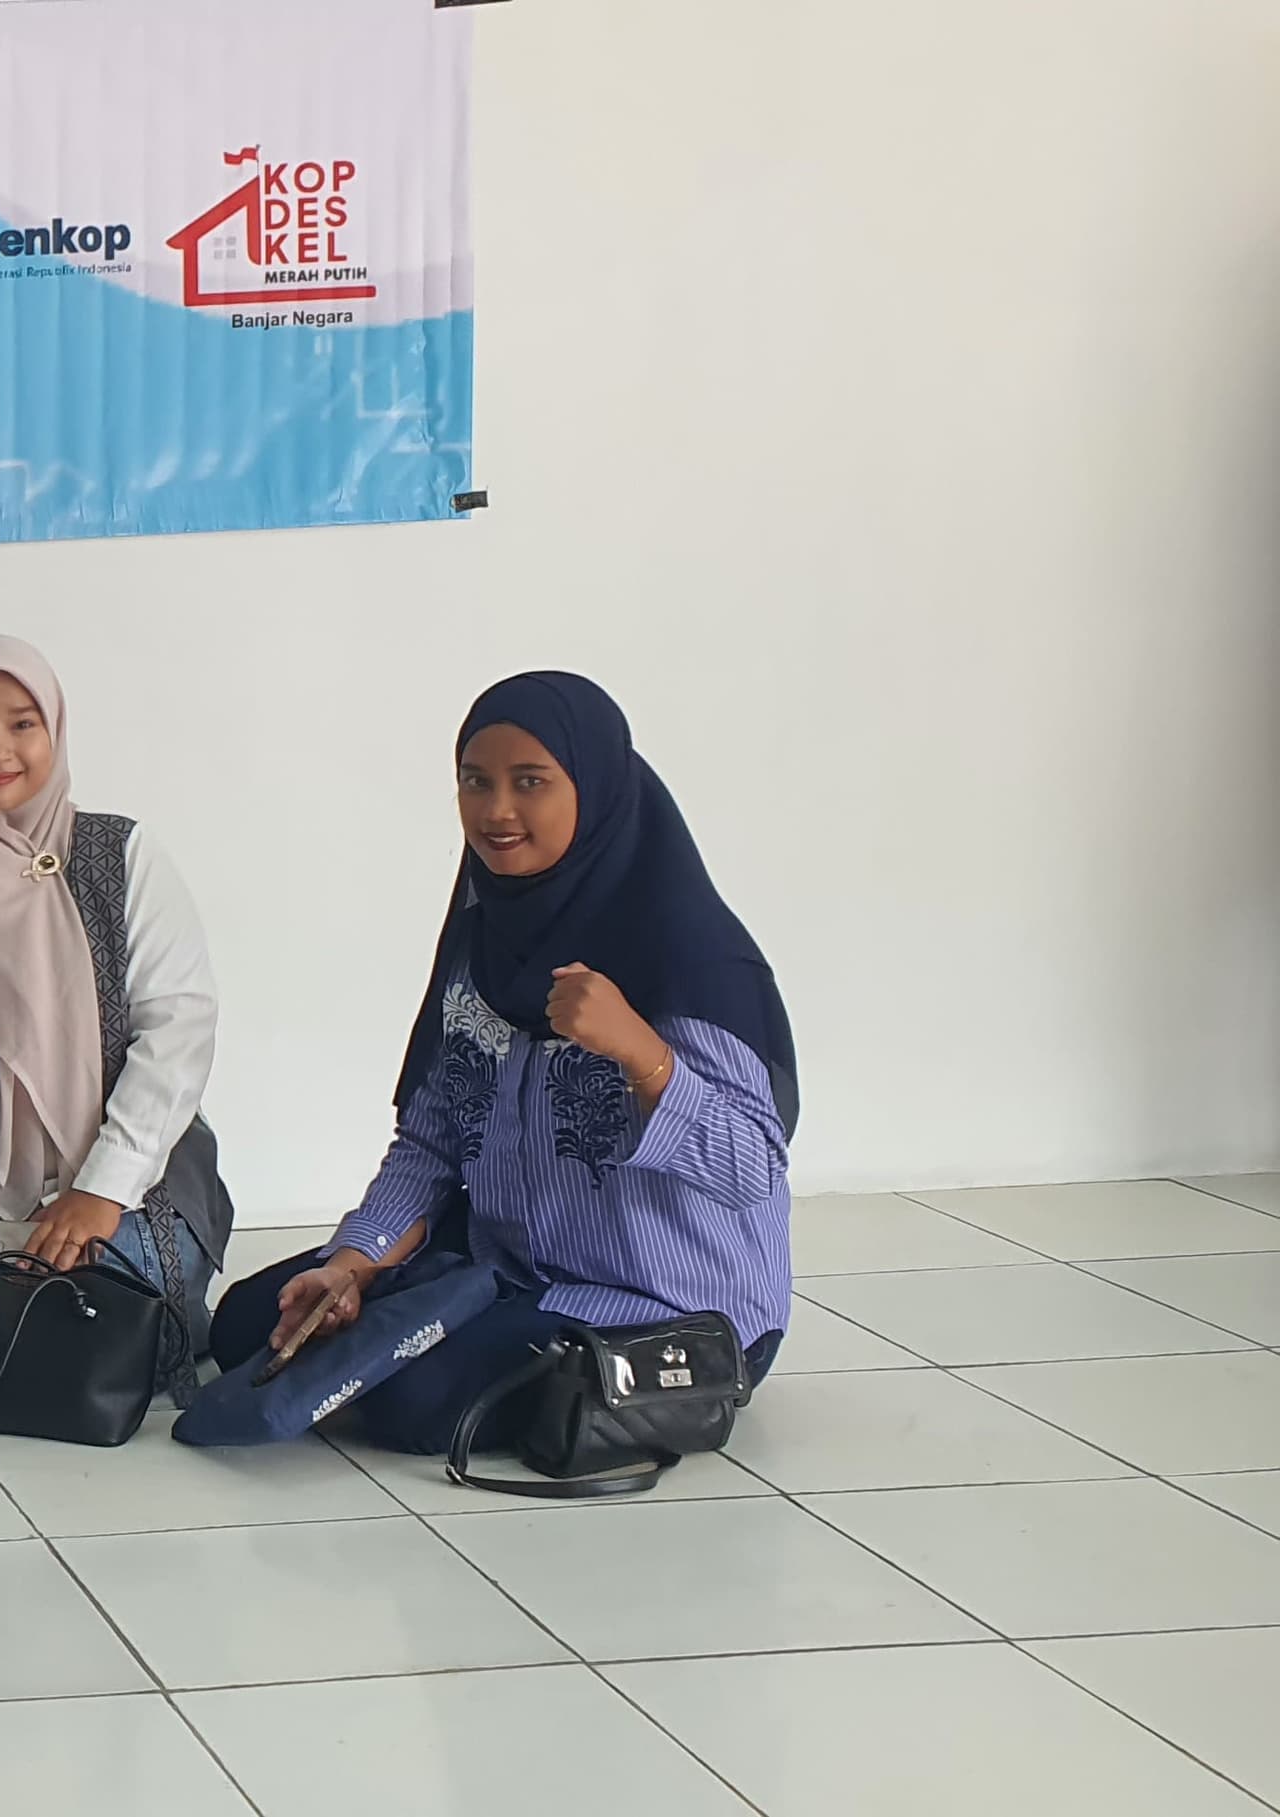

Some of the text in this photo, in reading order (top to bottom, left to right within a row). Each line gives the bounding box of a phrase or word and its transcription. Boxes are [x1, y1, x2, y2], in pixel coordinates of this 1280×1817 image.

[264, 161, 355, 195] KOP
[265, 197, 348, 230] DES
[265, 232, 348, 265] KEL
[264, 267, 368, 284] MERAH PUTIH
[232, 310, 353, 330] Banjar Negara
